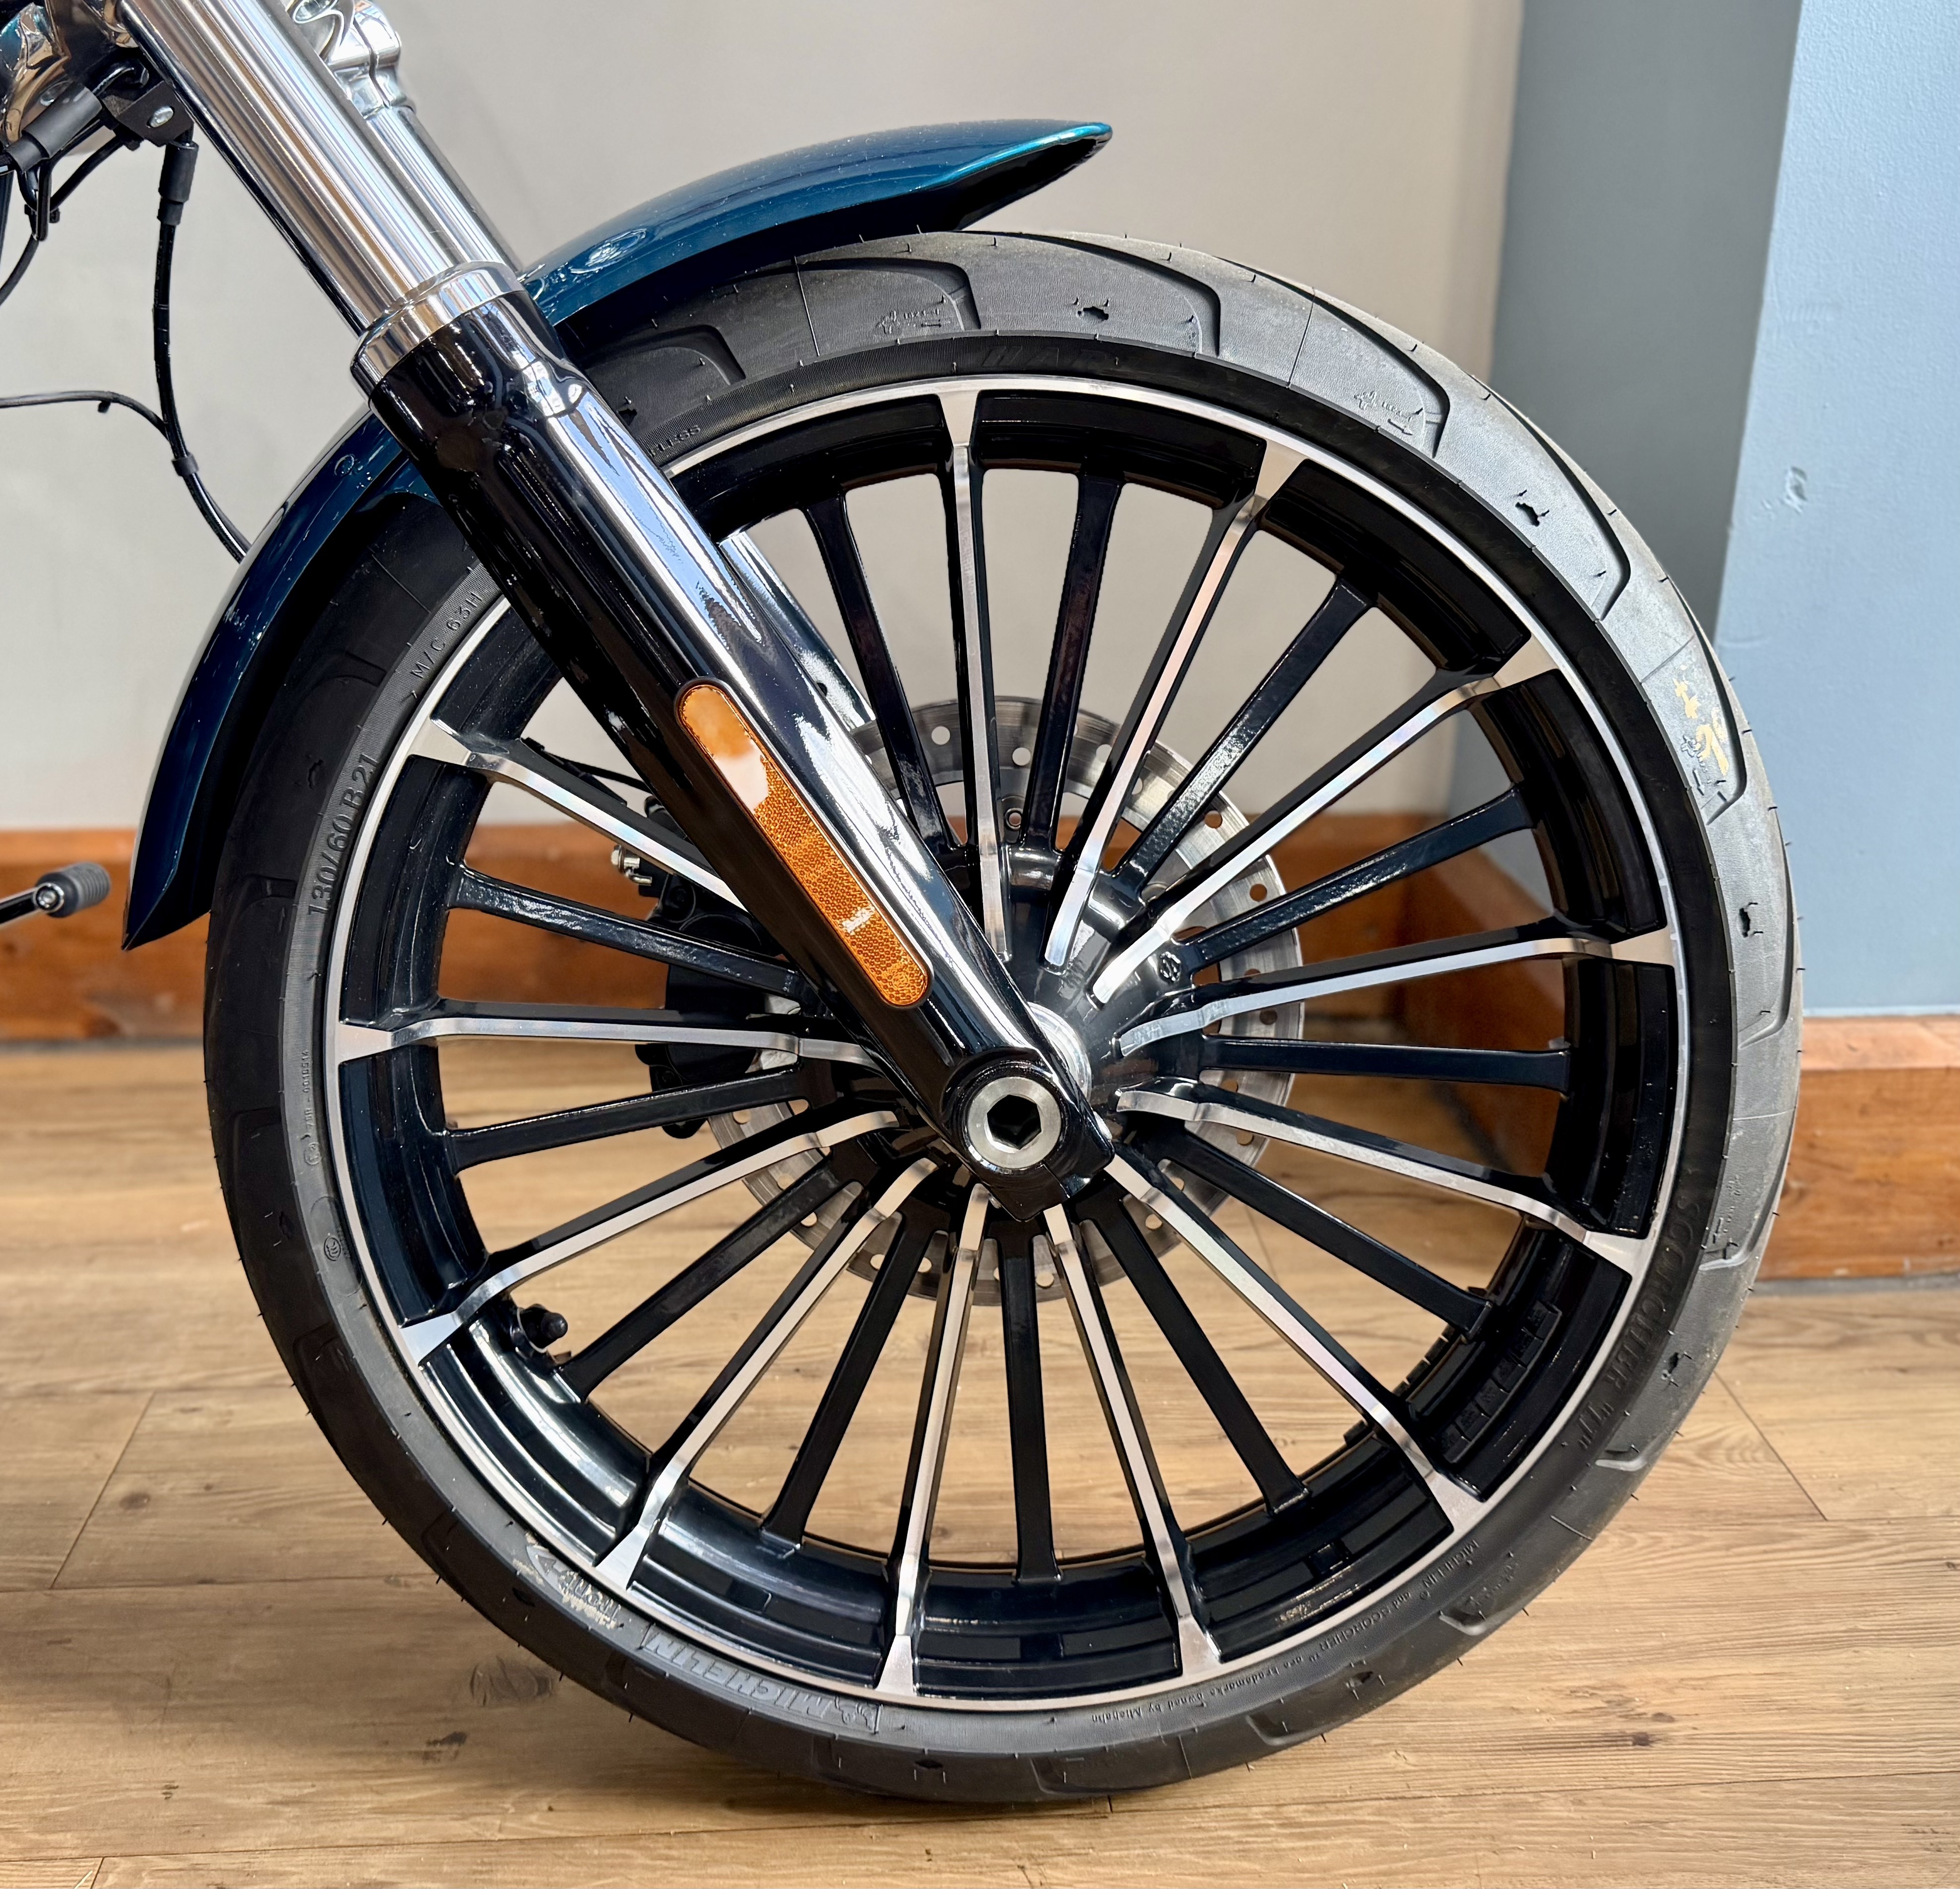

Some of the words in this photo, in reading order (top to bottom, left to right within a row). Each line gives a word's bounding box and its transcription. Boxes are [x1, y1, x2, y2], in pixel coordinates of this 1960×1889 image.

[337, 785, 364, 811] B
[347, 751, 378, 786] 21
[306, 811, 355, 918] 130/60
[645, 1628, 834, 1722] MICHELIN
